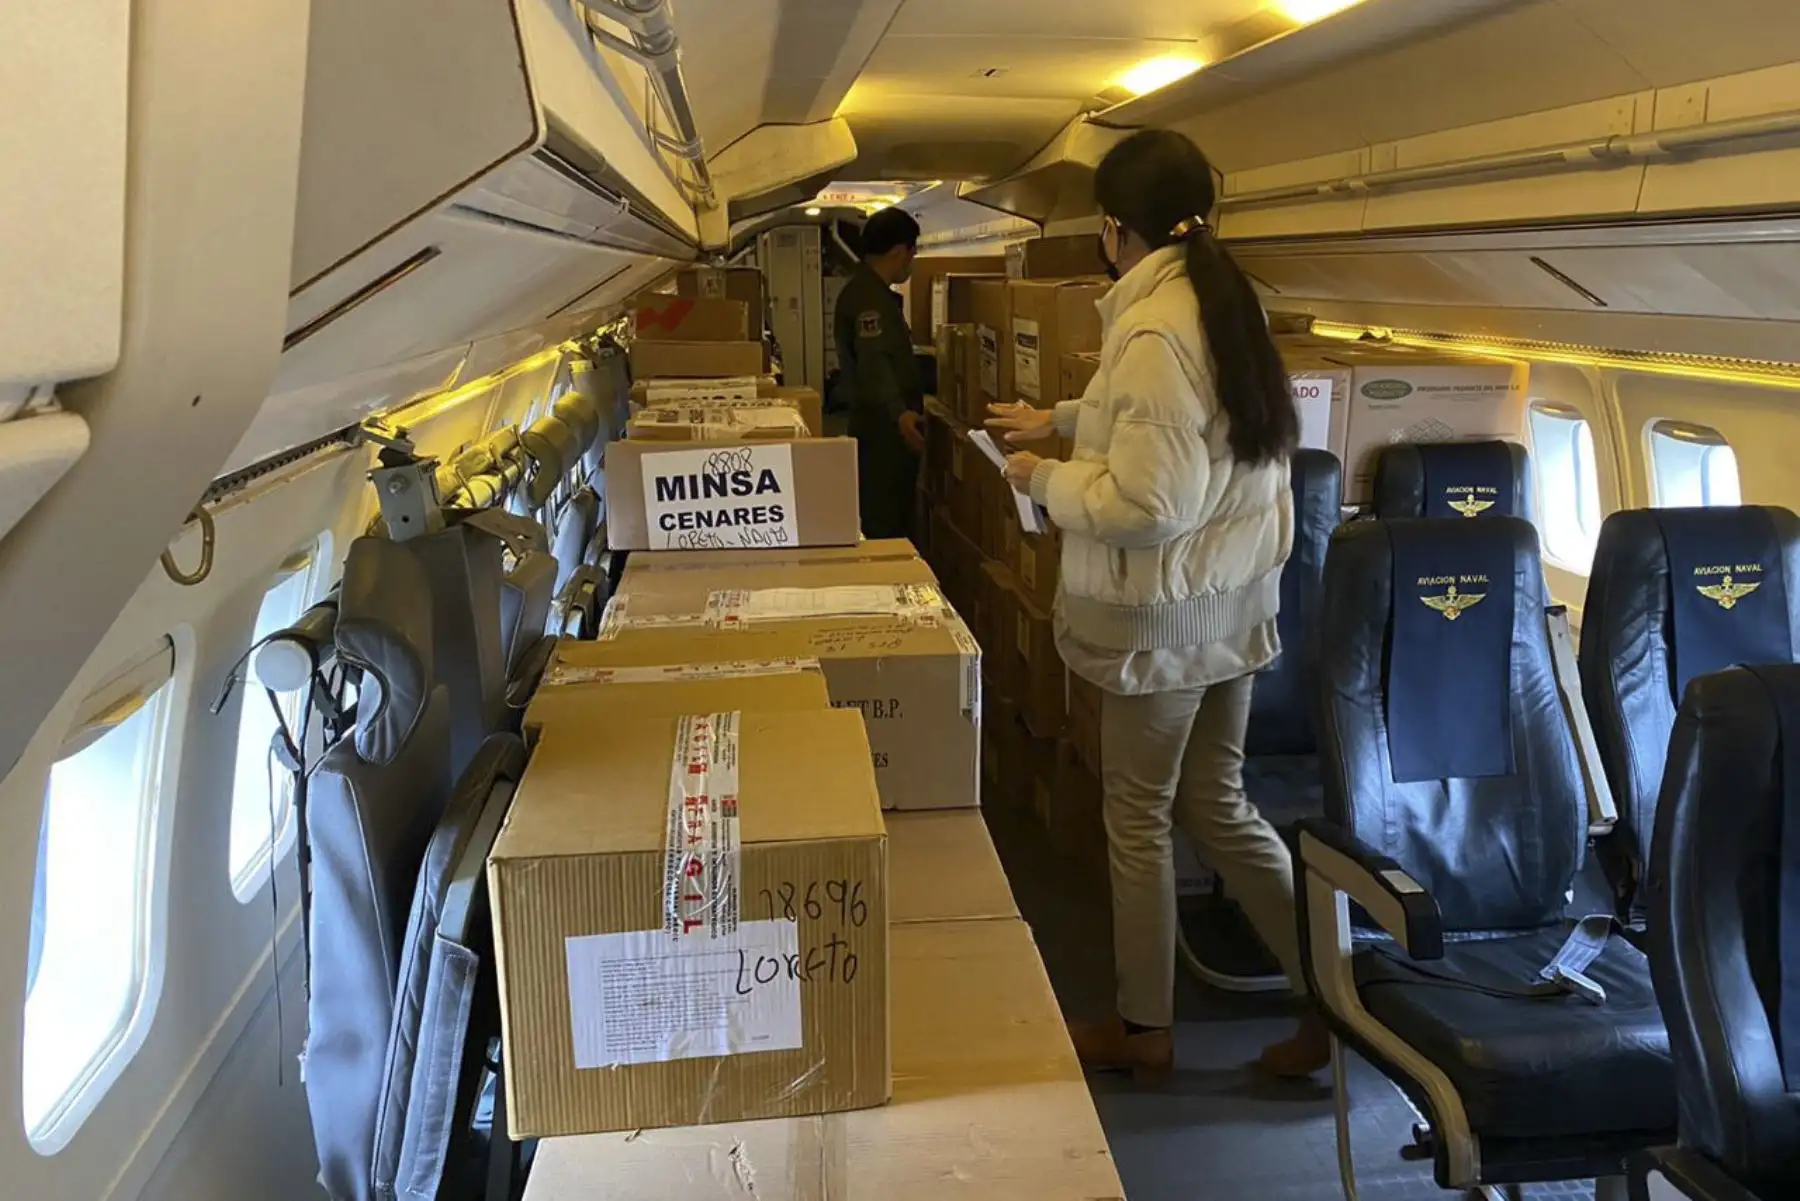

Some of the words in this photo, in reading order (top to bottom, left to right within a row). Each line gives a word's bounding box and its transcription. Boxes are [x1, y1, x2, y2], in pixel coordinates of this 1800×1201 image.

[655, 469, 781, 501] MINSA
[659, 504, 785, 531] CENARES
[1416, 575, 1456, 586] AVIACION
[1459, 574, 1490, 584] NAVAL
[1694, 565, 1732, 576] AVIACION
[1734, 563, 1764, 573] NAVAL
[873, 699, 903, 718] B.P.
[871, 752, 889, 768] ES
[759, 880, 867, 927] 18696
[734, 932, 858, 995] LORETO
